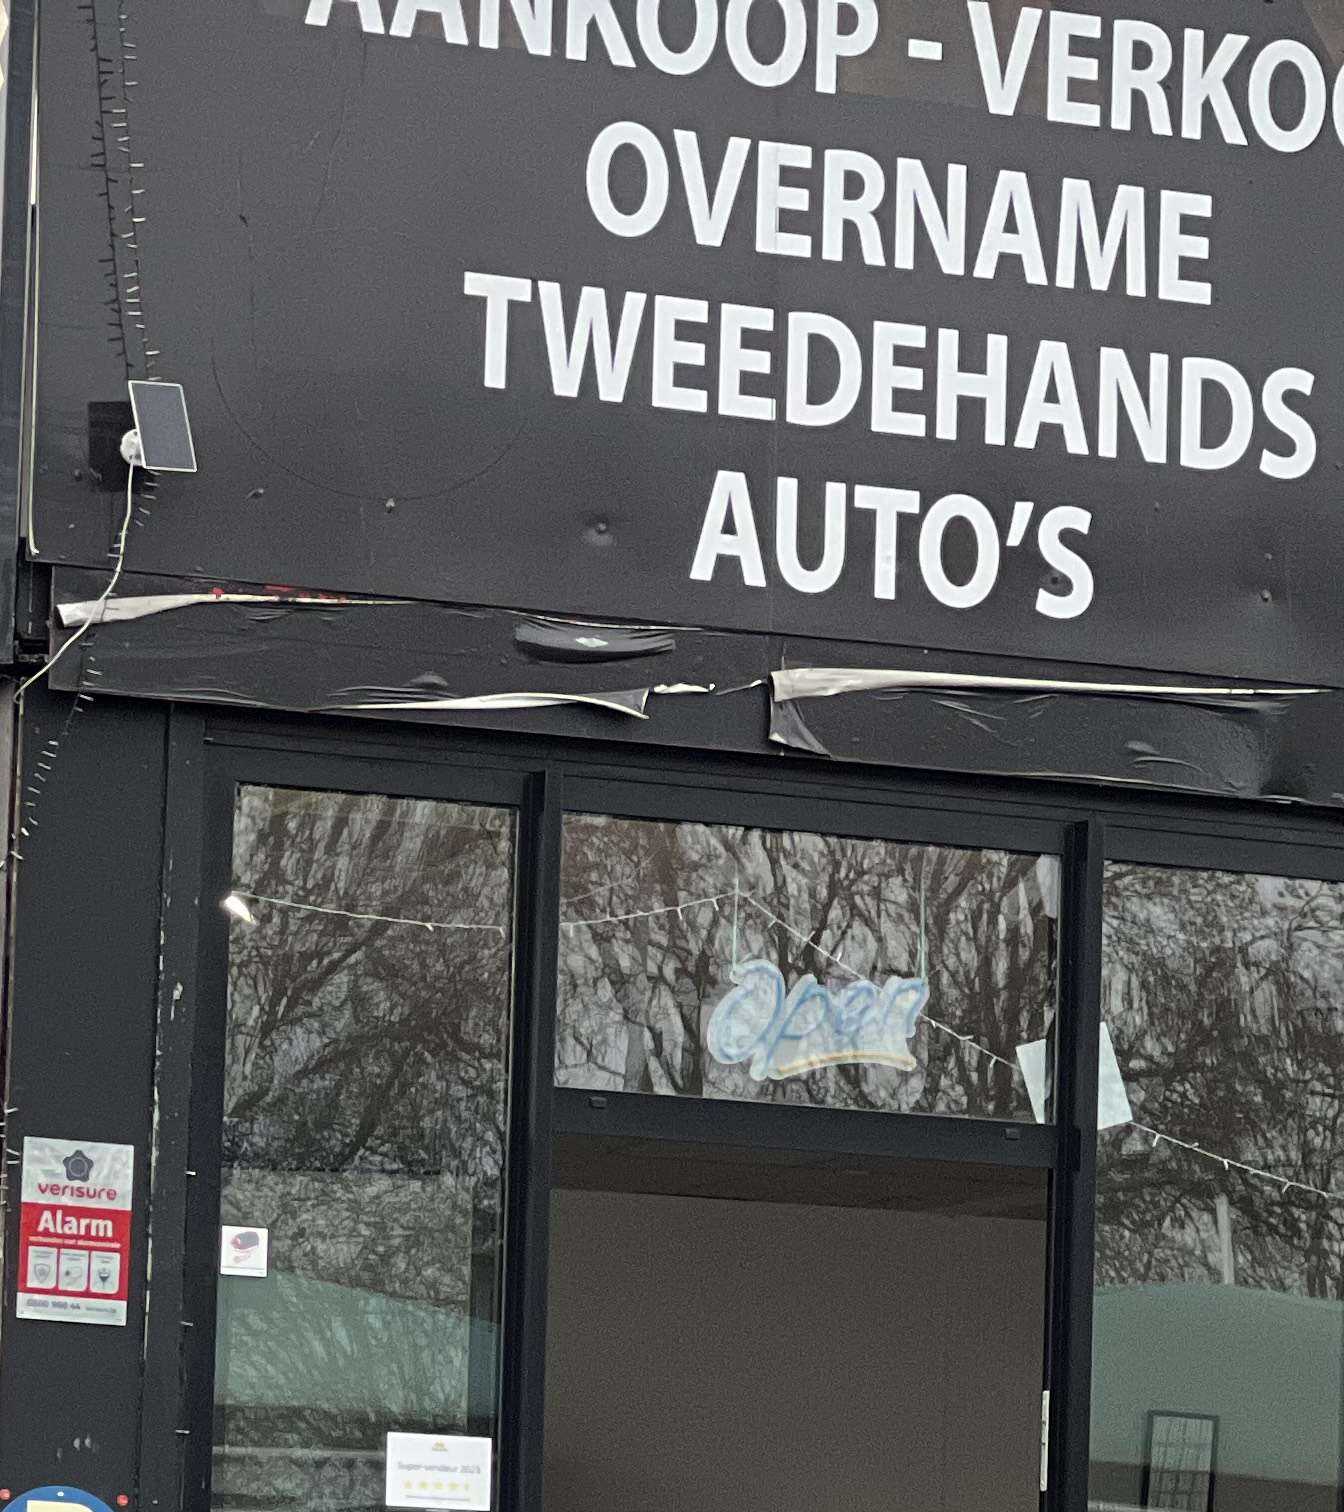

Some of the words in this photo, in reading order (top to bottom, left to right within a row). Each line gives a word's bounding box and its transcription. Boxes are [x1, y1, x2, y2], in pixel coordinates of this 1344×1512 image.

[585, 120, 1213, 306] OVERNAME
[463, 271, 1317, 480] TWEEDEHANDS
[689, 469, 1094, 619] AUTO'S
[36, 1209, 114, 1239] Alarm
[37, 1182, 118, 1201] verisure
